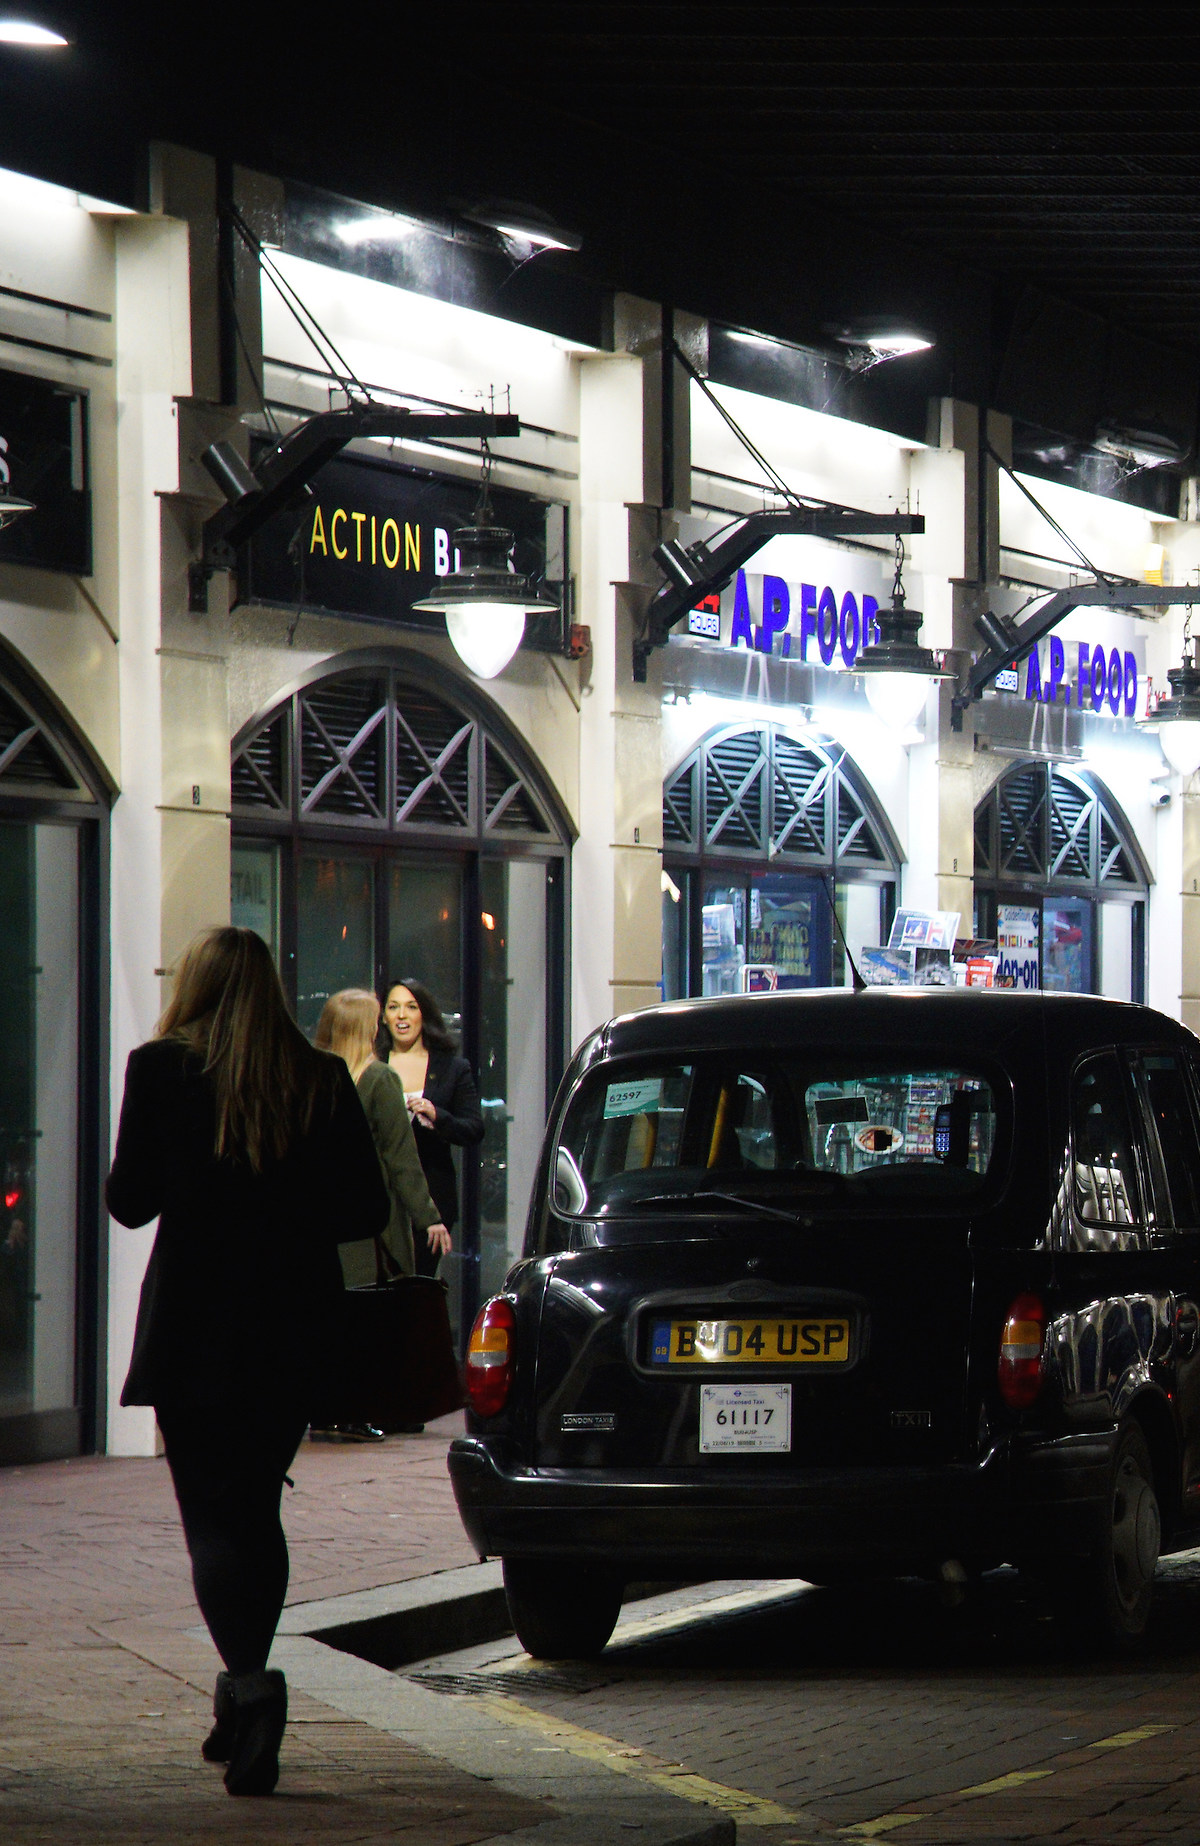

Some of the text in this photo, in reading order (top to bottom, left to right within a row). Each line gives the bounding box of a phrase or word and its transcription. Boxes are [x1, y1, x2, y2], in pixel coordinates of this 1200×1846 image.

[309, 504, 421, 573] ACTION
[800, 582, 881, 668] FOOD
[1077, 641, 1138, 718] FOOD
[231, 871, 267, 906] TAIL
[609, 1090, 642, 1103] 62597
[777, 1324, 845, 1356] USP
[563, 1417, 593, 1425] LONDON
[716, 1409, 774, 1426] 61117
